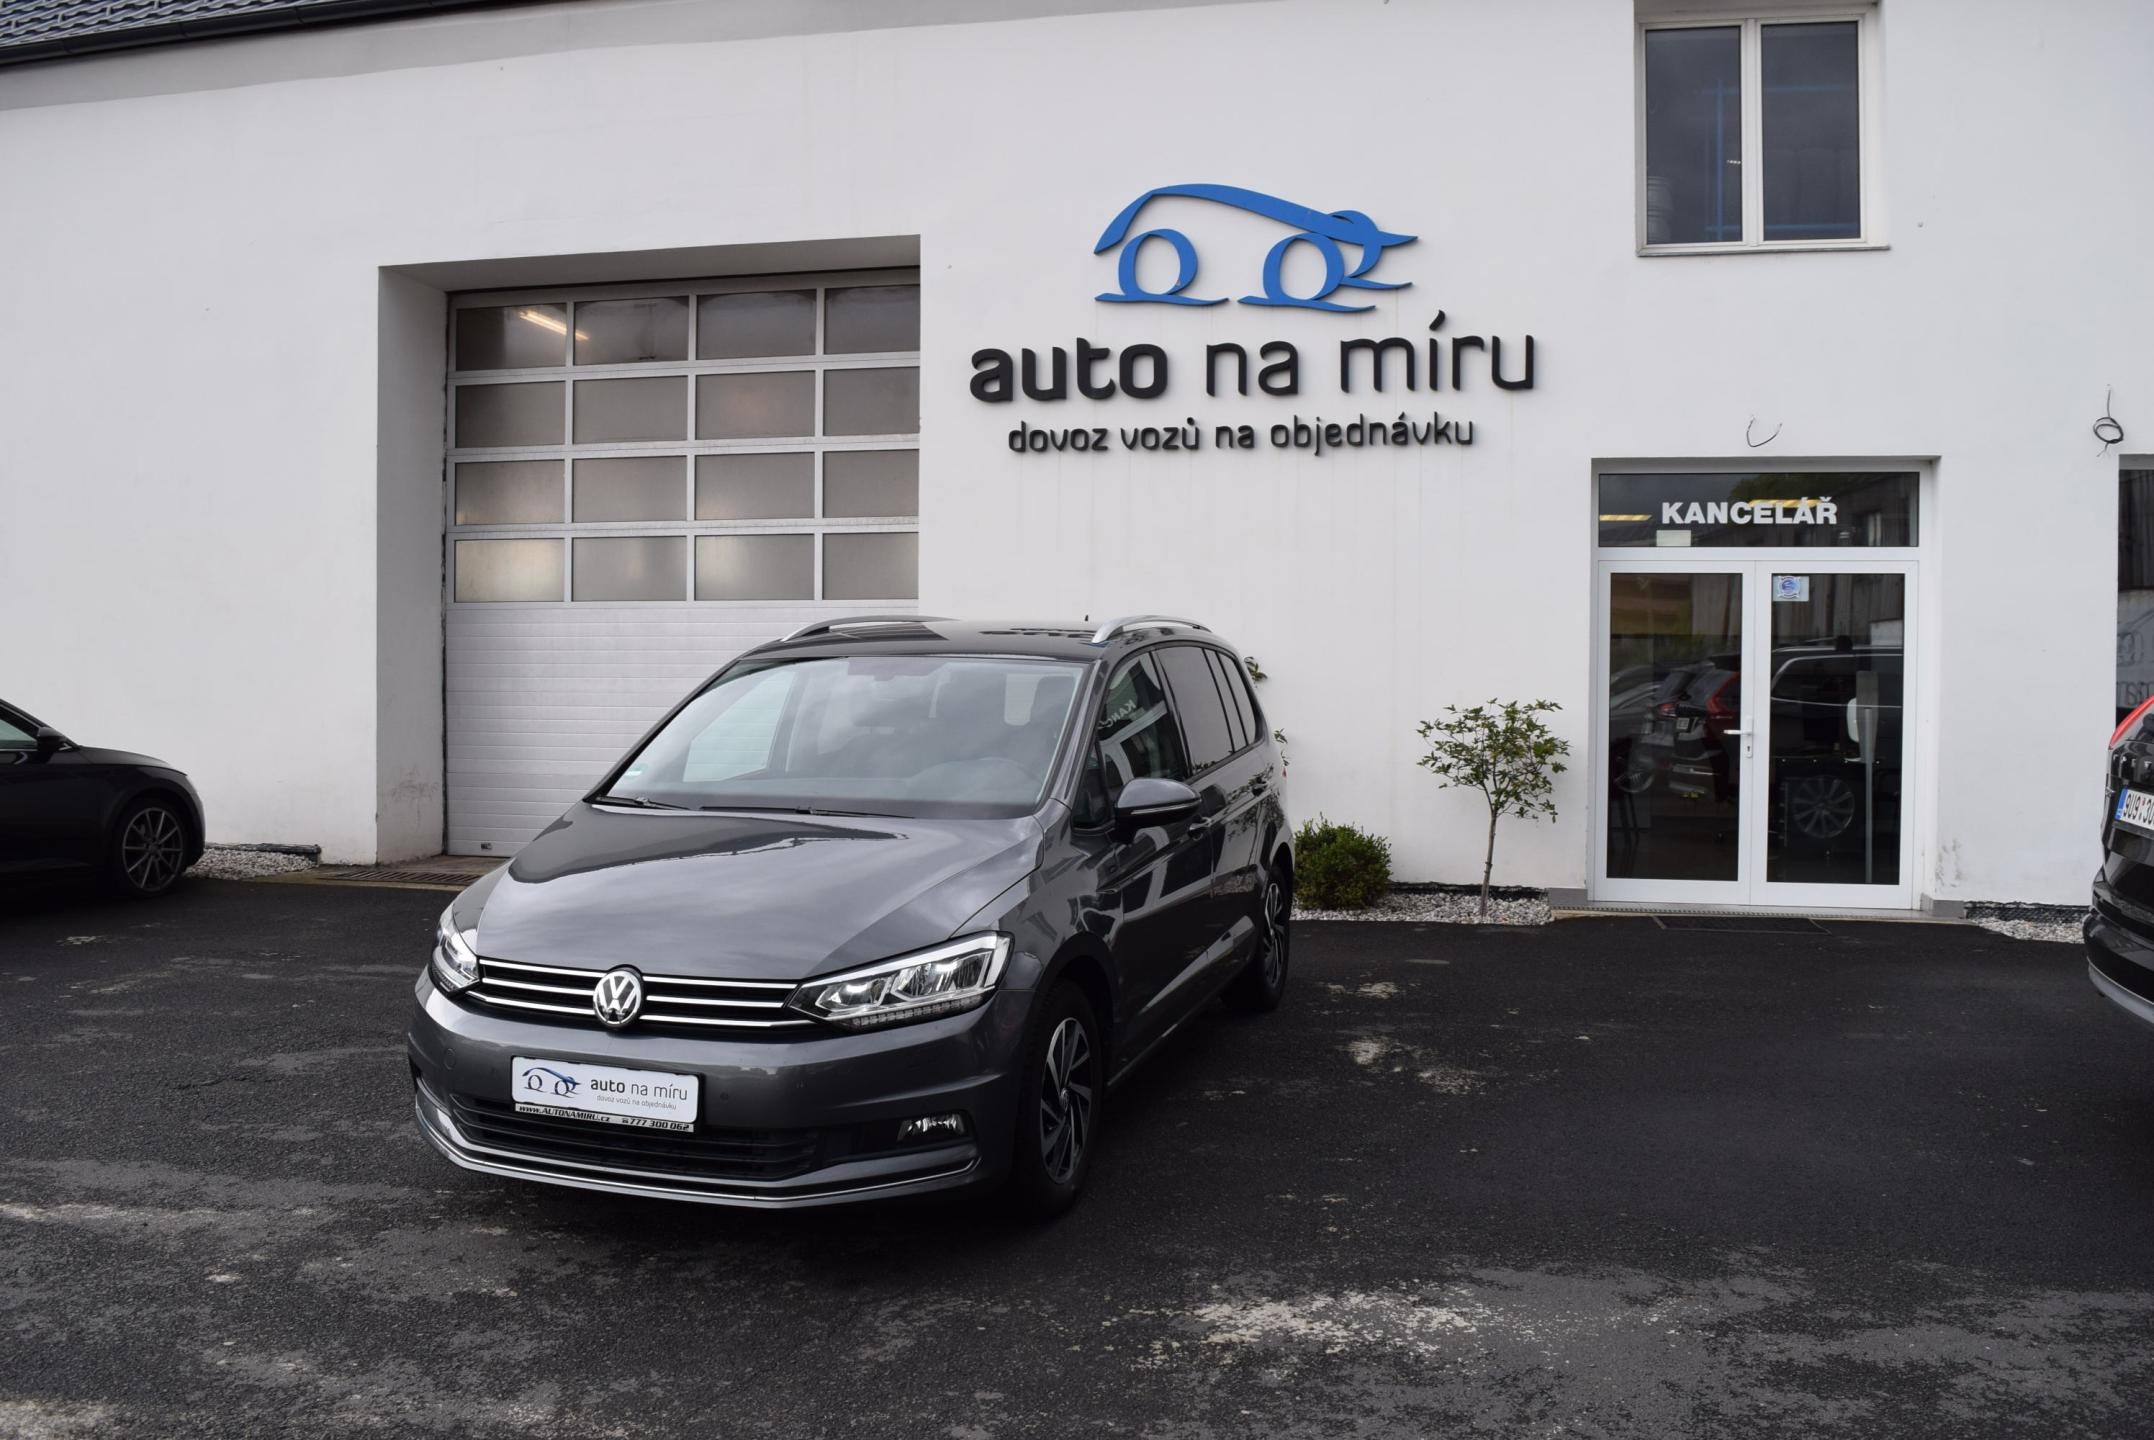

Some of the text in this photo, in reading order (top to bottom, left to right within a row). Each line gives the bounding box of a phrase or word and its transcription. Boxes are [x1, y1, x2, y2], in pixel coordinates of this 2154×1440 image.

[970, 309, 1534, 402] auto na míru
[1008, 411, 1474, 456] dovoz vozů na objednávku
[1661, 496, 1838, 525] KANCELÁŘ
[590, 1079, 688, 1101] auto na míru
[649, 1120, 669, 1129] 300
